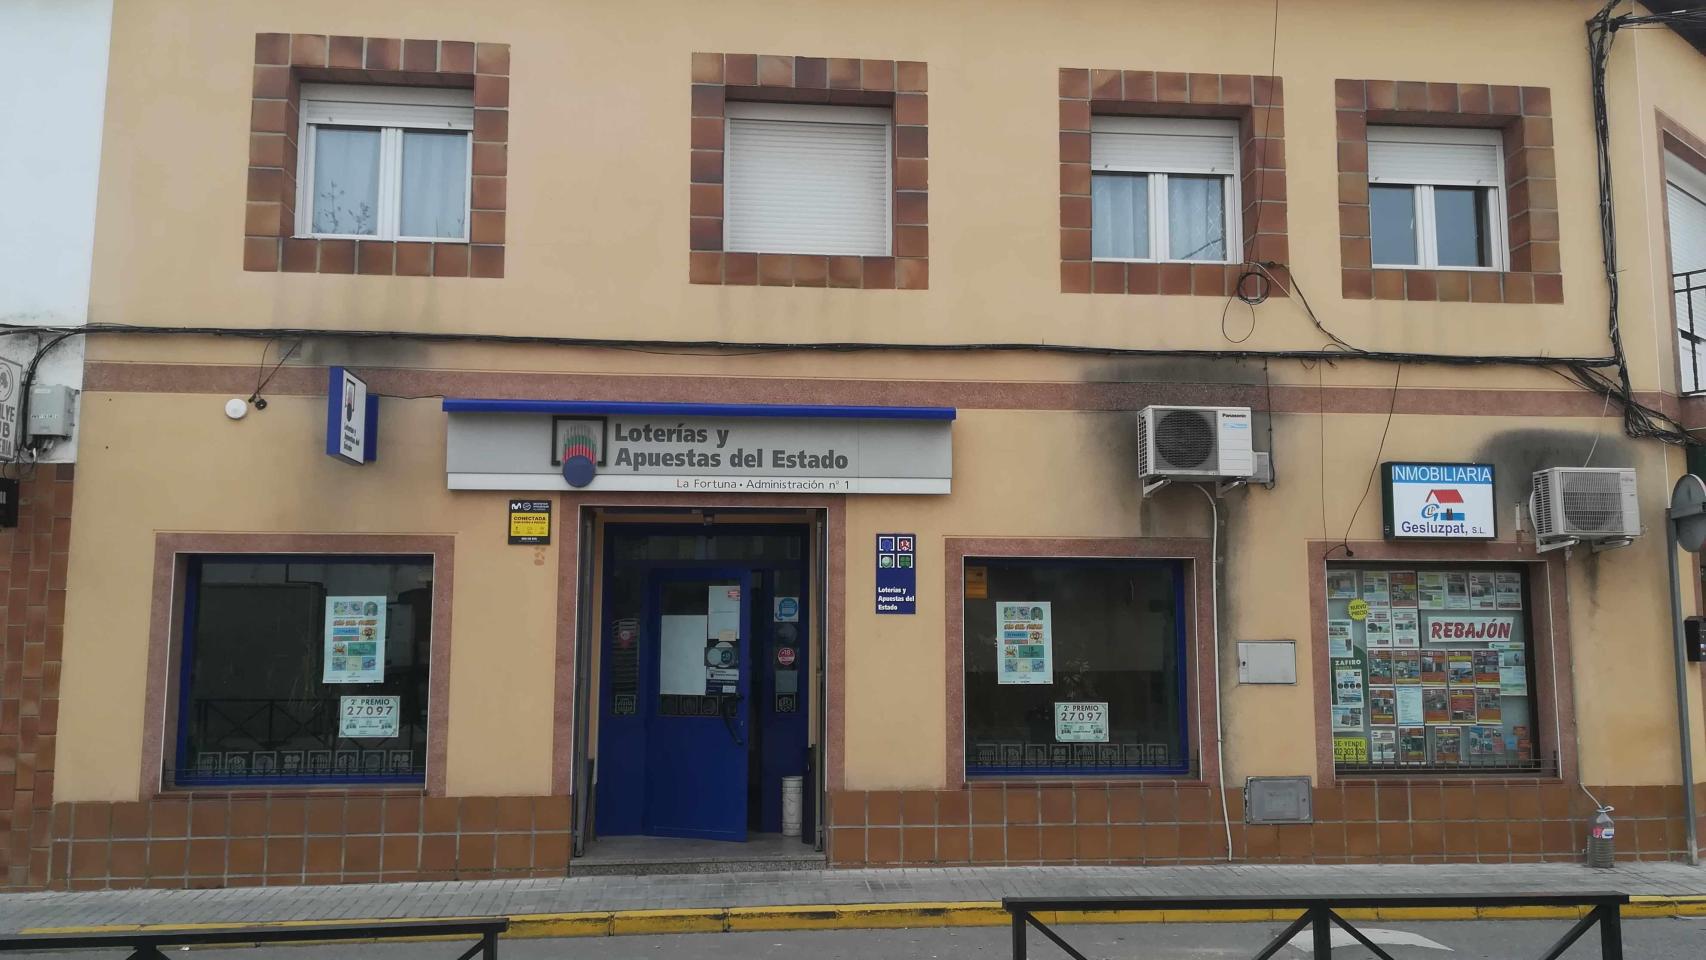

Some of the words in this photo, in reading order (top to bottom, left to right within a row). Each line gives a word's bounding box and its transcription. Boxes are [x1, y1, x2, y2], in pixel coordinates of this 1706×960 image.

[615, 423, 708, 443] Loterías
[716, 429, 730, 448] y
[614, 448, 722, 471] Apuestas
[729, 448, 763, 468] del
[772, 449, 849, 469] Estado
[1392, 465, 1492, 482] INMOBILIARIA
[676, 479, 689, 488] La
[694, 479, 737, 489] Fortuna
[746, 479, 825, 490] Administración
[845, 480, 849, 490] 1
[1401, 521, 1468, 536] Gesluzpat,
[1472, 526, 1487, 534] S.L.
[878, 595, 905, 603] Apuestas
[1431, 618, 1511, 639] REBAJÓN
[347, 706, 393, 716] 27097
[1060, 712, 1102, 721] 27097
